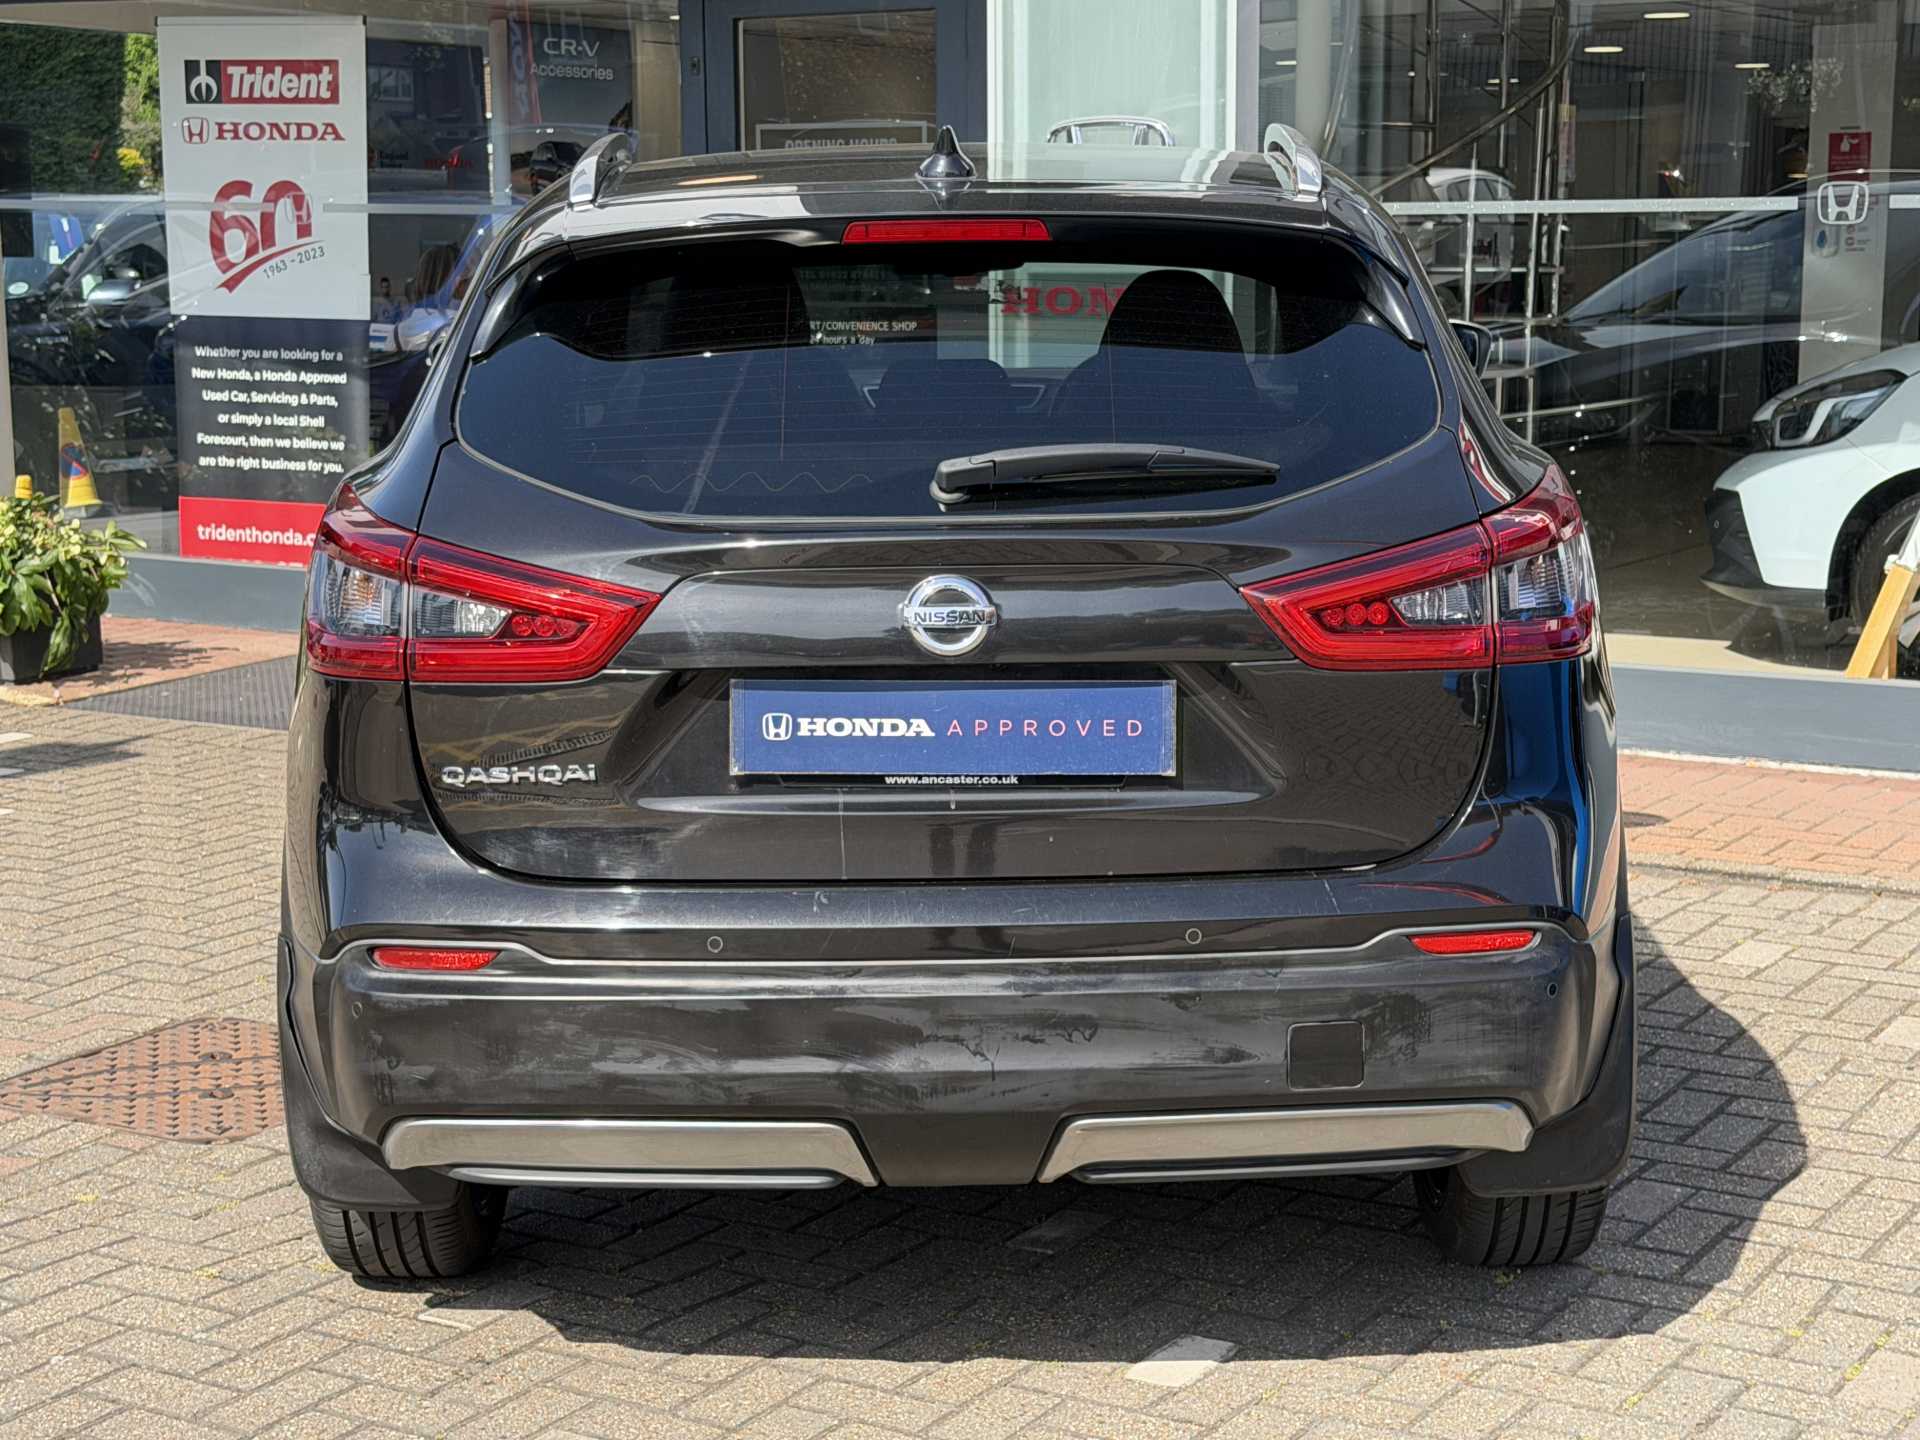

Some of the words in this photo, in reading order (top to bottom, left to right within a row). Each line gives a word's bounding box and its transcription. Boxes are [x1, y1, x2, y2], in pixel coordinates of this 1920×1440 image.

[529, 63, 614, 81] Accessories
[227, 65, 333, 99] Trident
[215, 121, 346, 142] HONDA
[262, 258, 289, 280] 1963
[297, 245, 326, 266] 2023
[892, 321, 918, 332] SHOP
[823, 334, 848, 345] hours
[194, 346, 240, 358] Whether
[242, 350, 260, 361] you
[262, 350, 278, 359] are
[280, 349, 319, 362] looking
[321, 349, 334, 361] for
[336, 352, 344, 361] a
[191, 367, 215, 379] New
[217, 368, 253, 382] Honda,
[254, 371, 262, 381] a
[262, 370, 298, 382] Honda
[298, 371, 348, 385] Approved
[202, 390, 229, 402] Used
[230, 390, 250, 404] Car,
[251, 391, 299, 407] Servicing
[300, 393, 308, 404] &
[309, 393, 339, 408] Parts,
[217, 413, 230, 424] or
[231, 412, 263, 427] simply
[264, 416, 273, 426] a
[273, 414, 298, 427] local
[299, 415, 325, 428] Shell
[196, 432, 249, 448] Forecourt,
[249, 434, 274, 447] then
[275, 437, 292, 448] we
[293, 437, 329, 450] believe
[330, 441, 345, 450] we
[199, 456, 217, 466] are
[218, 456, 236, 468] the
[236, 456, 260, 471] right
[261, 457, 306, 471] business
[307, 459, 322, 472] for
[323, 463, 344, 475] you.
[913, 609, 986, 623] NISSAN
[797, 717, 935, 737] HONDA
[946, 718, 1144, 737] APPROVED
[441, 763, 596, 788] QASHQAI
[884, 774, 1019, 787] www.ancaster.co.uk
